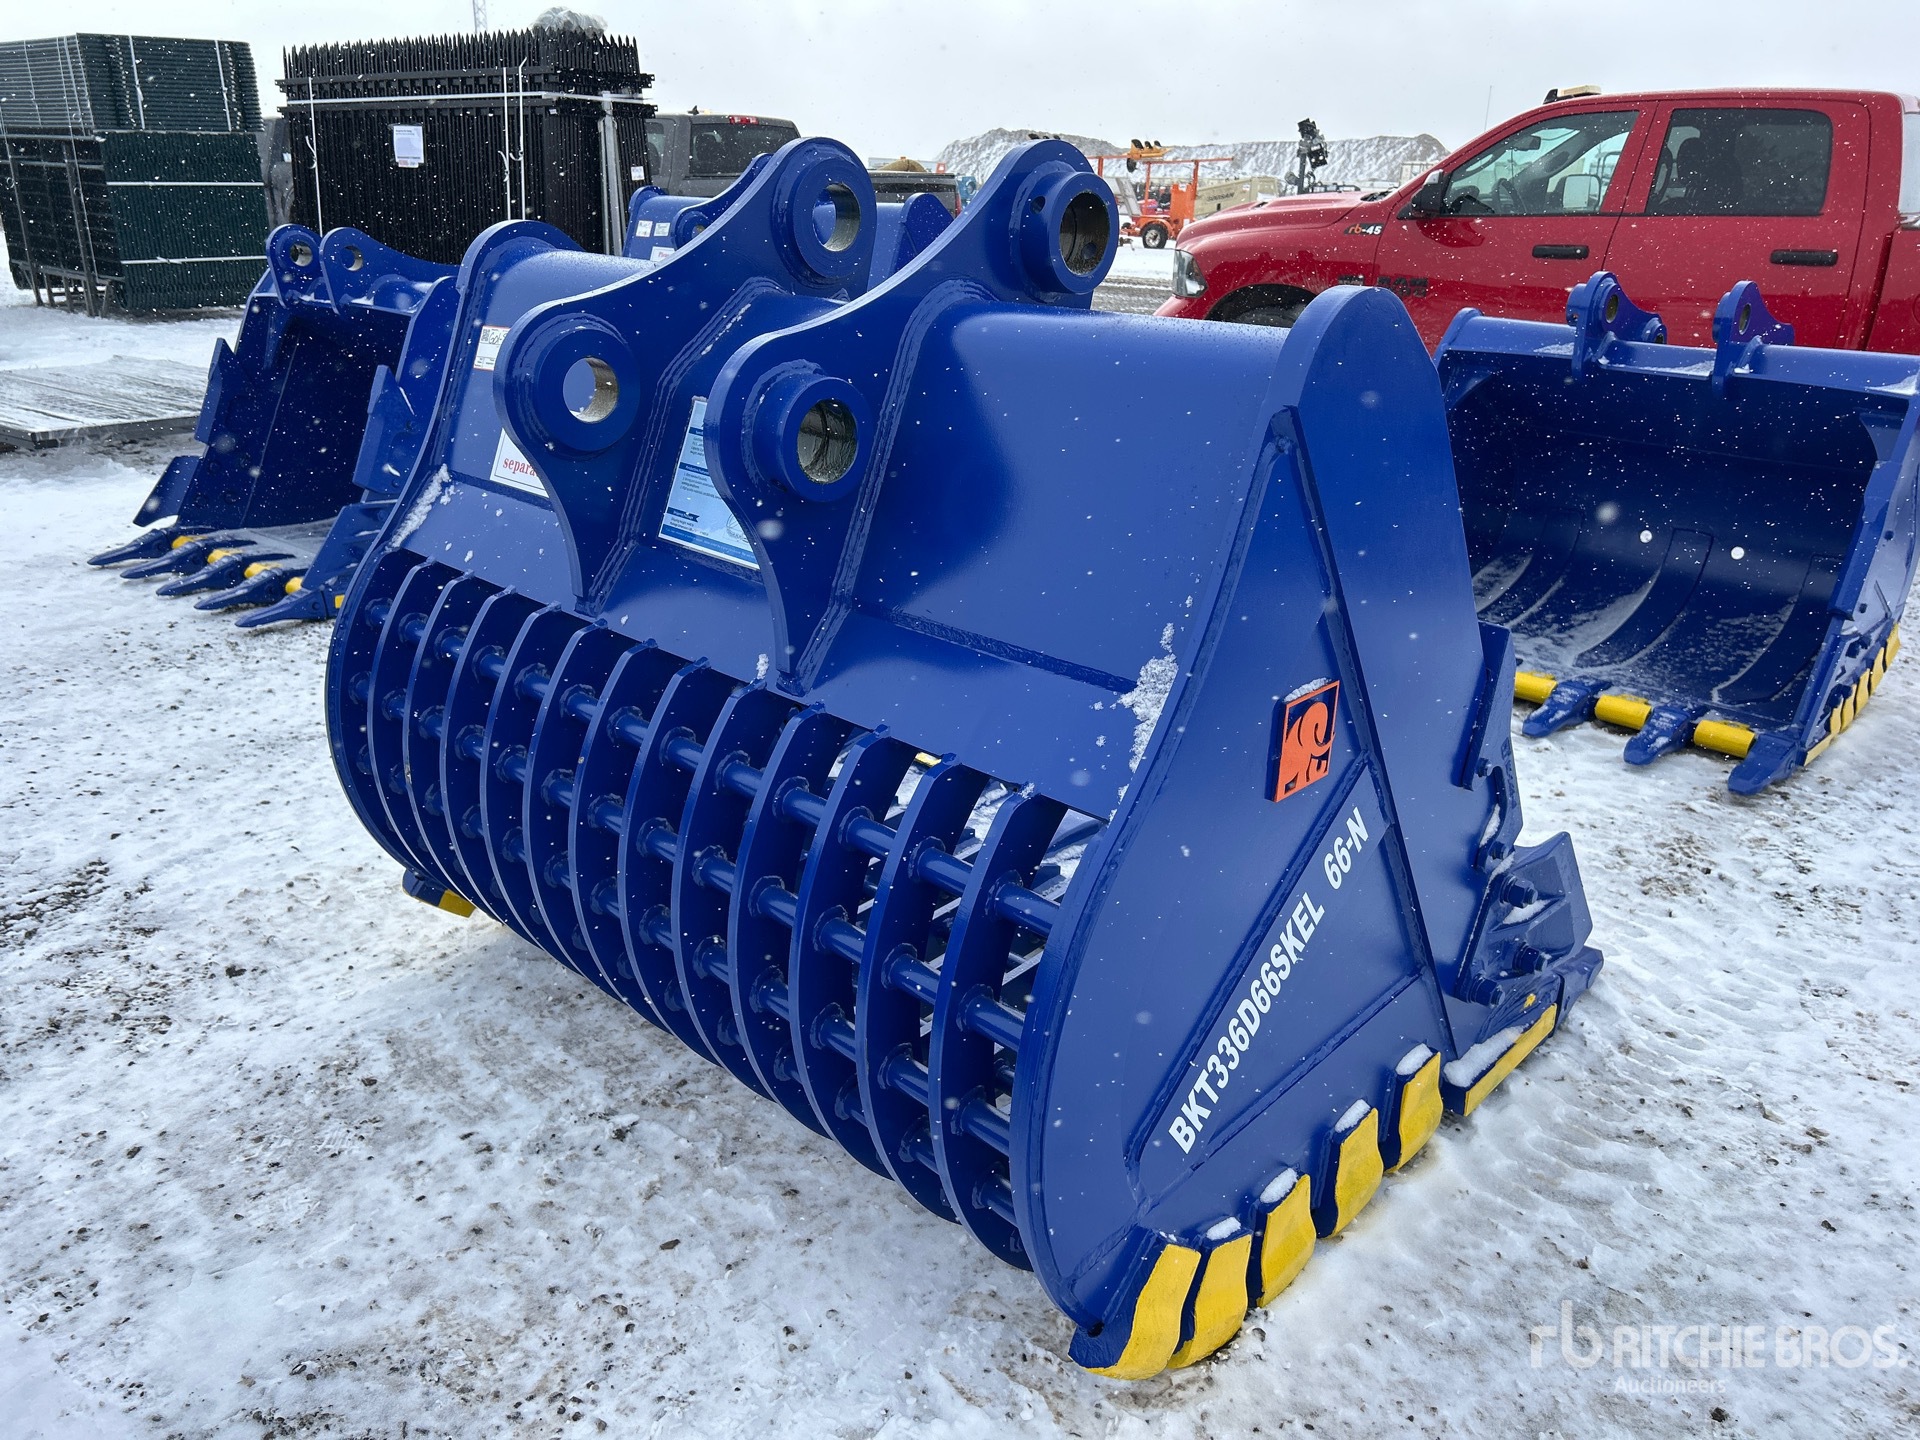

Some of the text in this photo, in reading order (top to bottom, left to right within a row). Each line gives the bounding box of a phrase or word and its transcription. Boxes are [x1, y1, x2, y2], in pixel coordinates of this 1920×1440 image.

[1348, 223, 1383, 235] rb-45
[1324, 806, 1369, 890] 66-N
[1168, 892, 1326, 1155] BKT336D66SKEL
